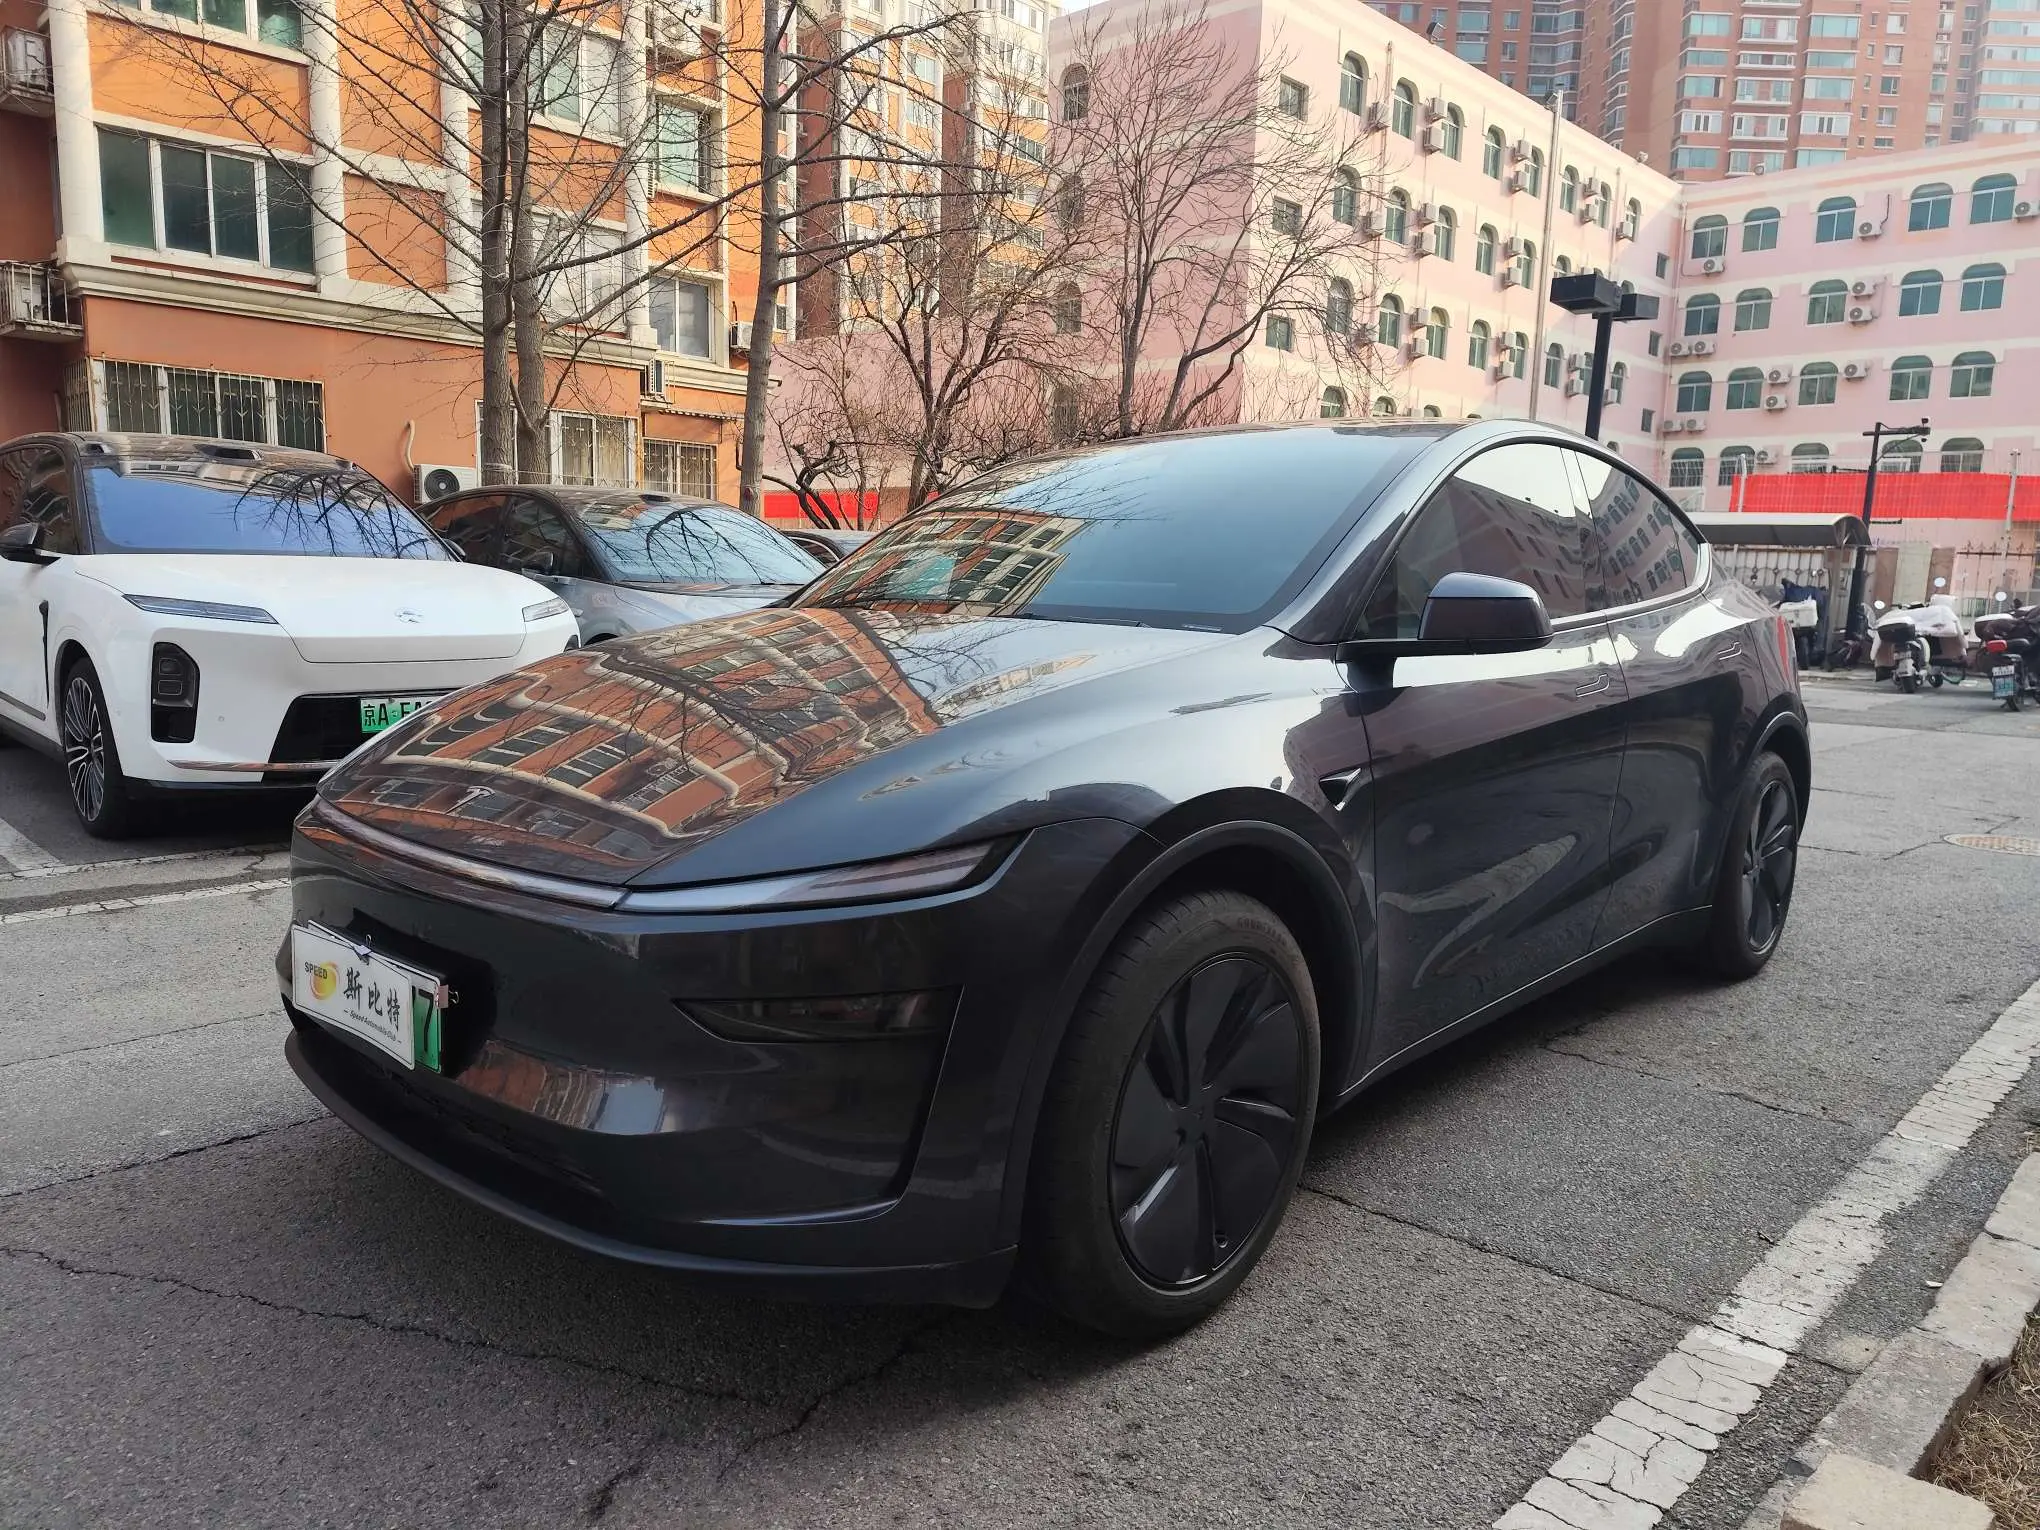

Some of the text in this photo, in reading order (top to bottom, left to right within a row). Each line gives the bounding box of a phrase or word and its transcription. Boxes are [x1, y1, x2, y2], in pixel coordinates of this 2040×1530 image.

[304, 961, 328, 980] SPEED
[343, 967, 400, 1032] 斯比特
[350, 1010, 365, 1023] Speed
[411, 985, 434, 1053] 7
